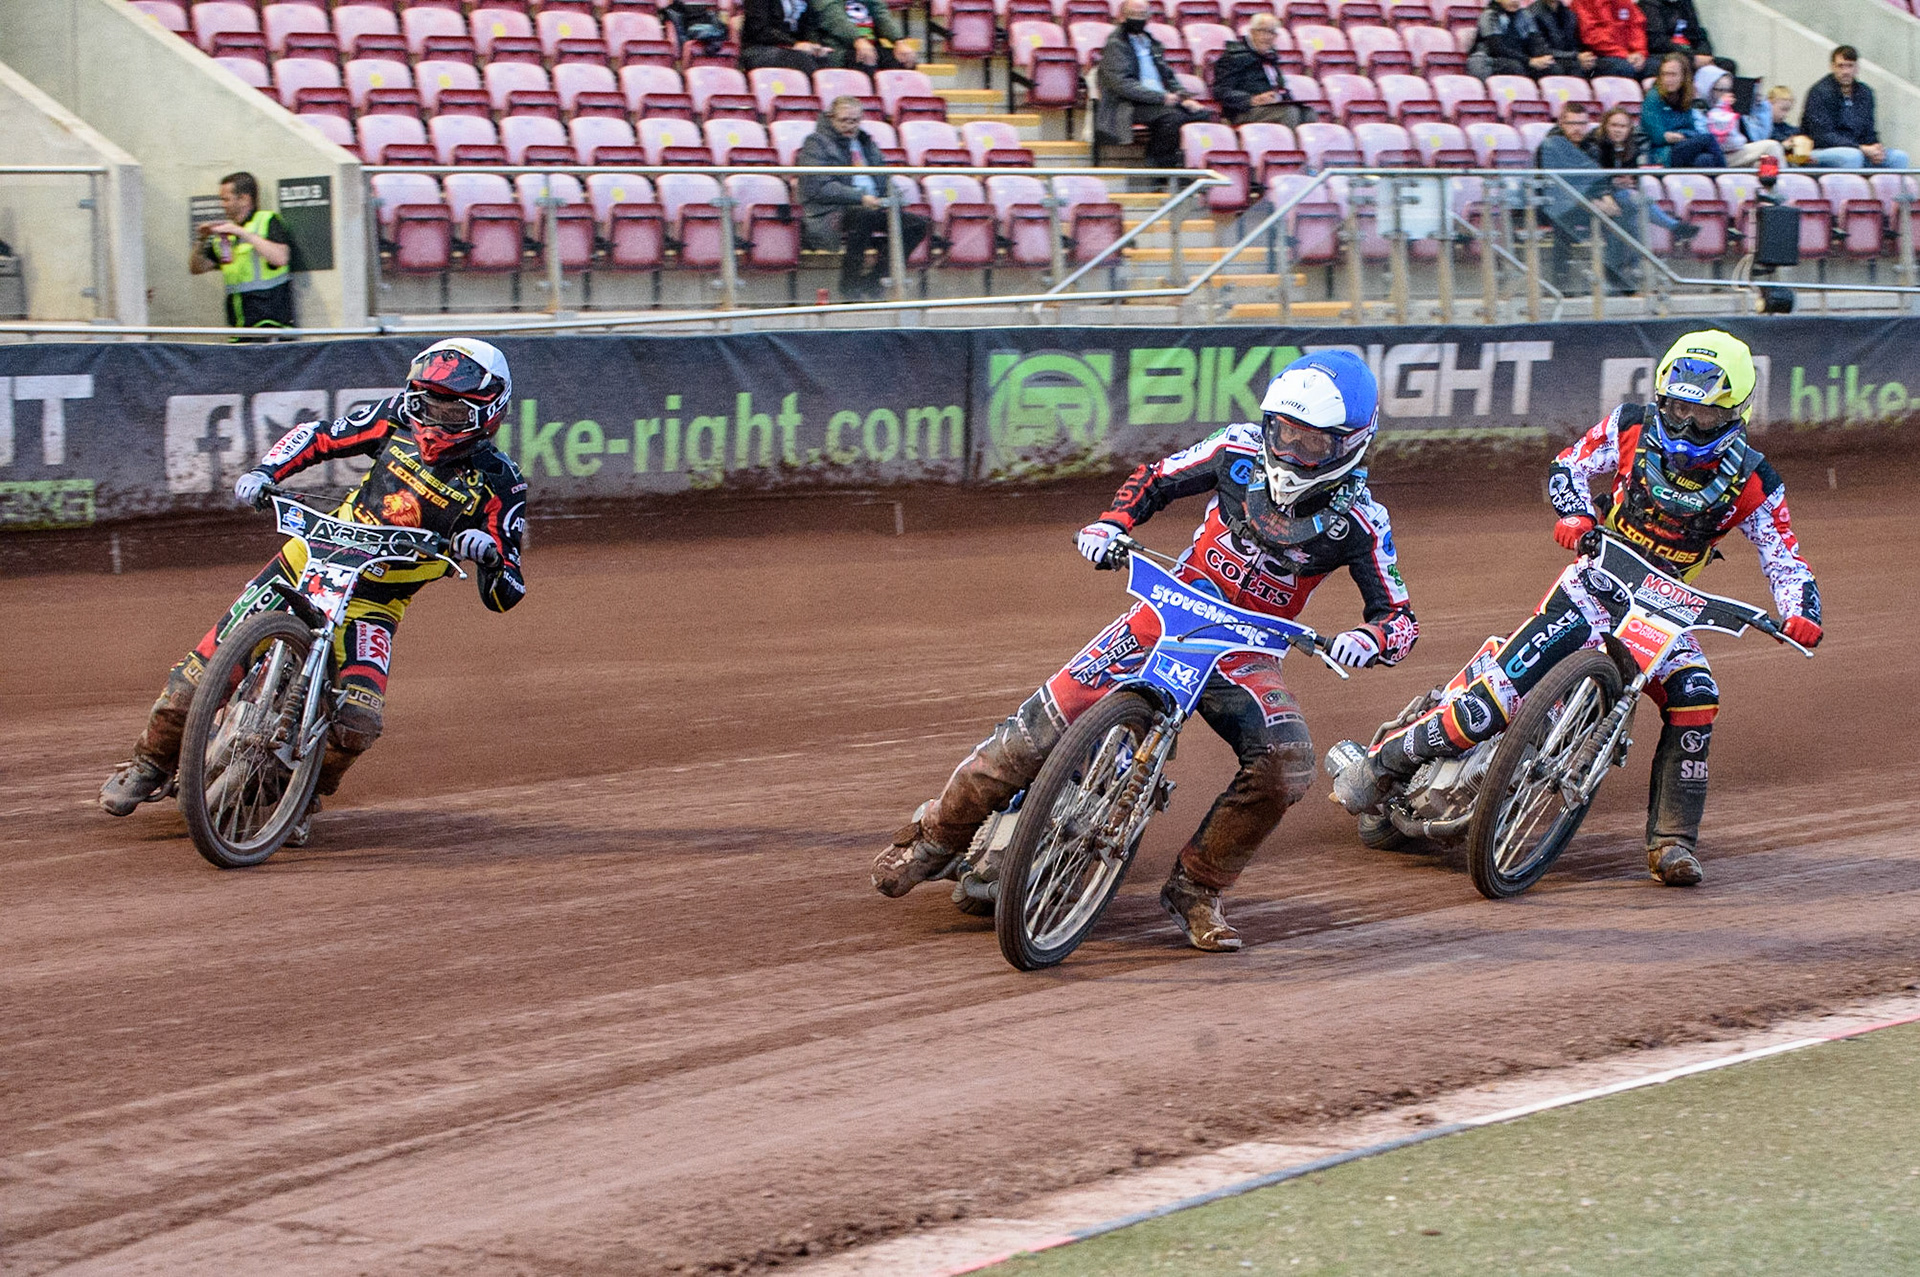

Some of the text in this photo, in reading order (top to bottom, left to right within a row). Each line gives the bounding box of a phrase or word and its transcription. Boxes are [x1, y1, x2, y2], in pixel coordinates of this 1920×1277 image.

[1281, 400, 1306, 413] SHOEI
[1667, 385, 1706, 399] Arai
[497, 391, 965, 489] ike-right.com
[387, 460, 450, 510] LEICESTER
[389, 445, 469, 505] ROGER WEBSTER
[310, 519, 383, 546] AYRES
[1617, 517, 1700, 564] LION CUBS
[1205, 548, 1293, 607] COLTS
[1643, 574, 1706, 614] MOTIVE
[369, 628, 390, 668] NGK
[1505, 609, 1580, 679] GC RACE
[348, 688, 381, 710] JCB
